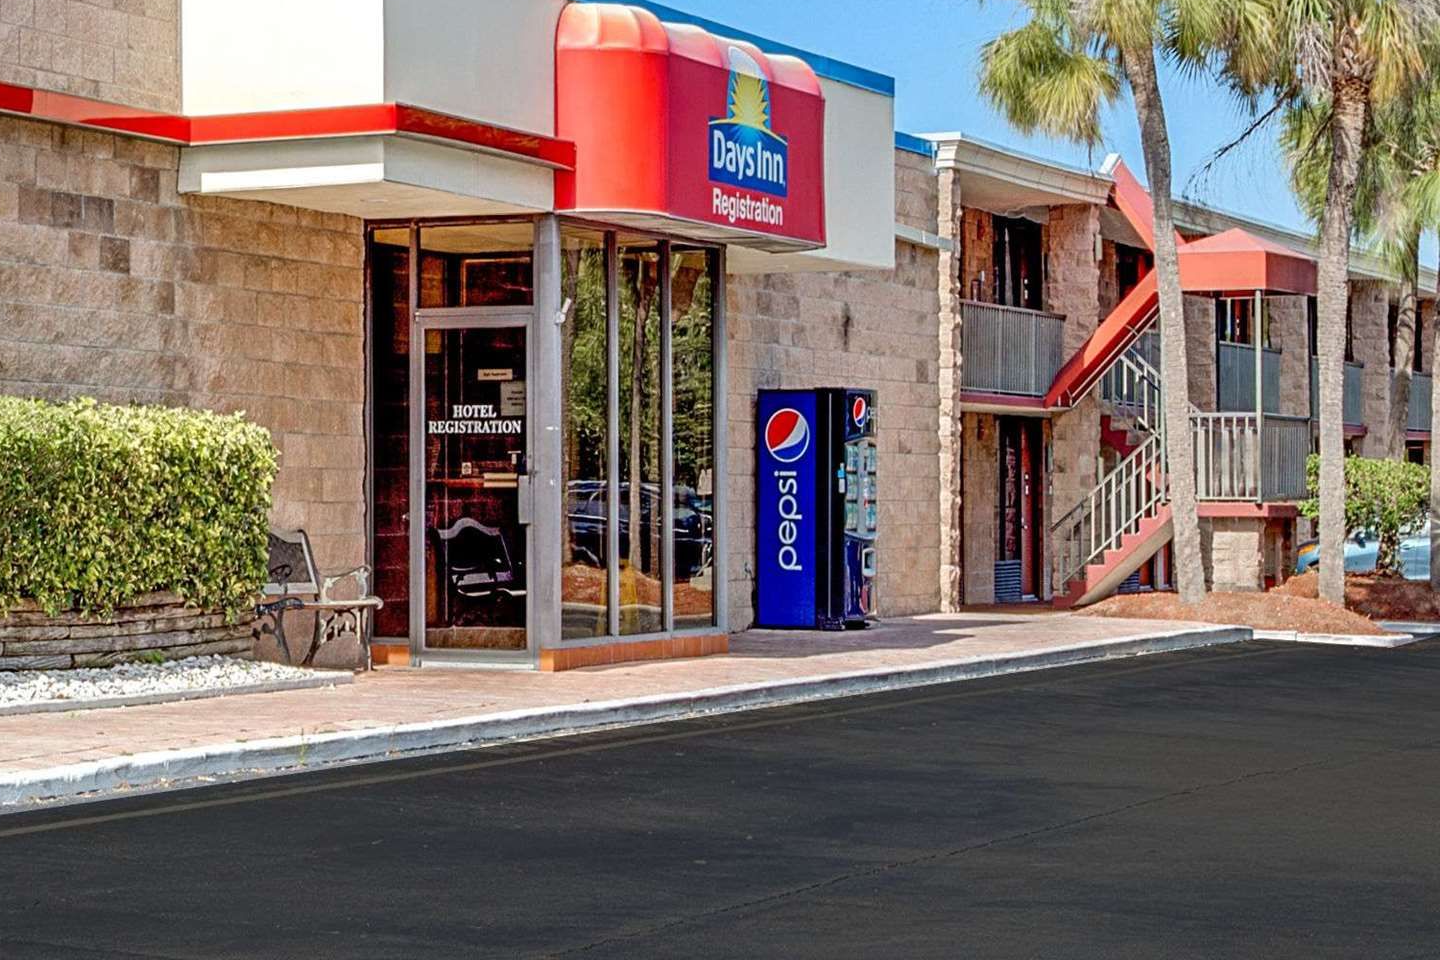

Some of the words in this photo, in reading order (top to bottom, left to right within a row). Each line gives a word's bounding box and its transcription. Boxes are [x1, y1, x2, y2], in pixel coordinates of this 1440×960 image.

[713, 129, 755, 180] Days
[757, 141, 784, 184] Inn
[712, 187, 783, 226] Registration
[428, 420, 522, 434] REGISTRATION
[452, 404, 497, 418] HOTEL
[773, 470, 803, 572] pepsi
